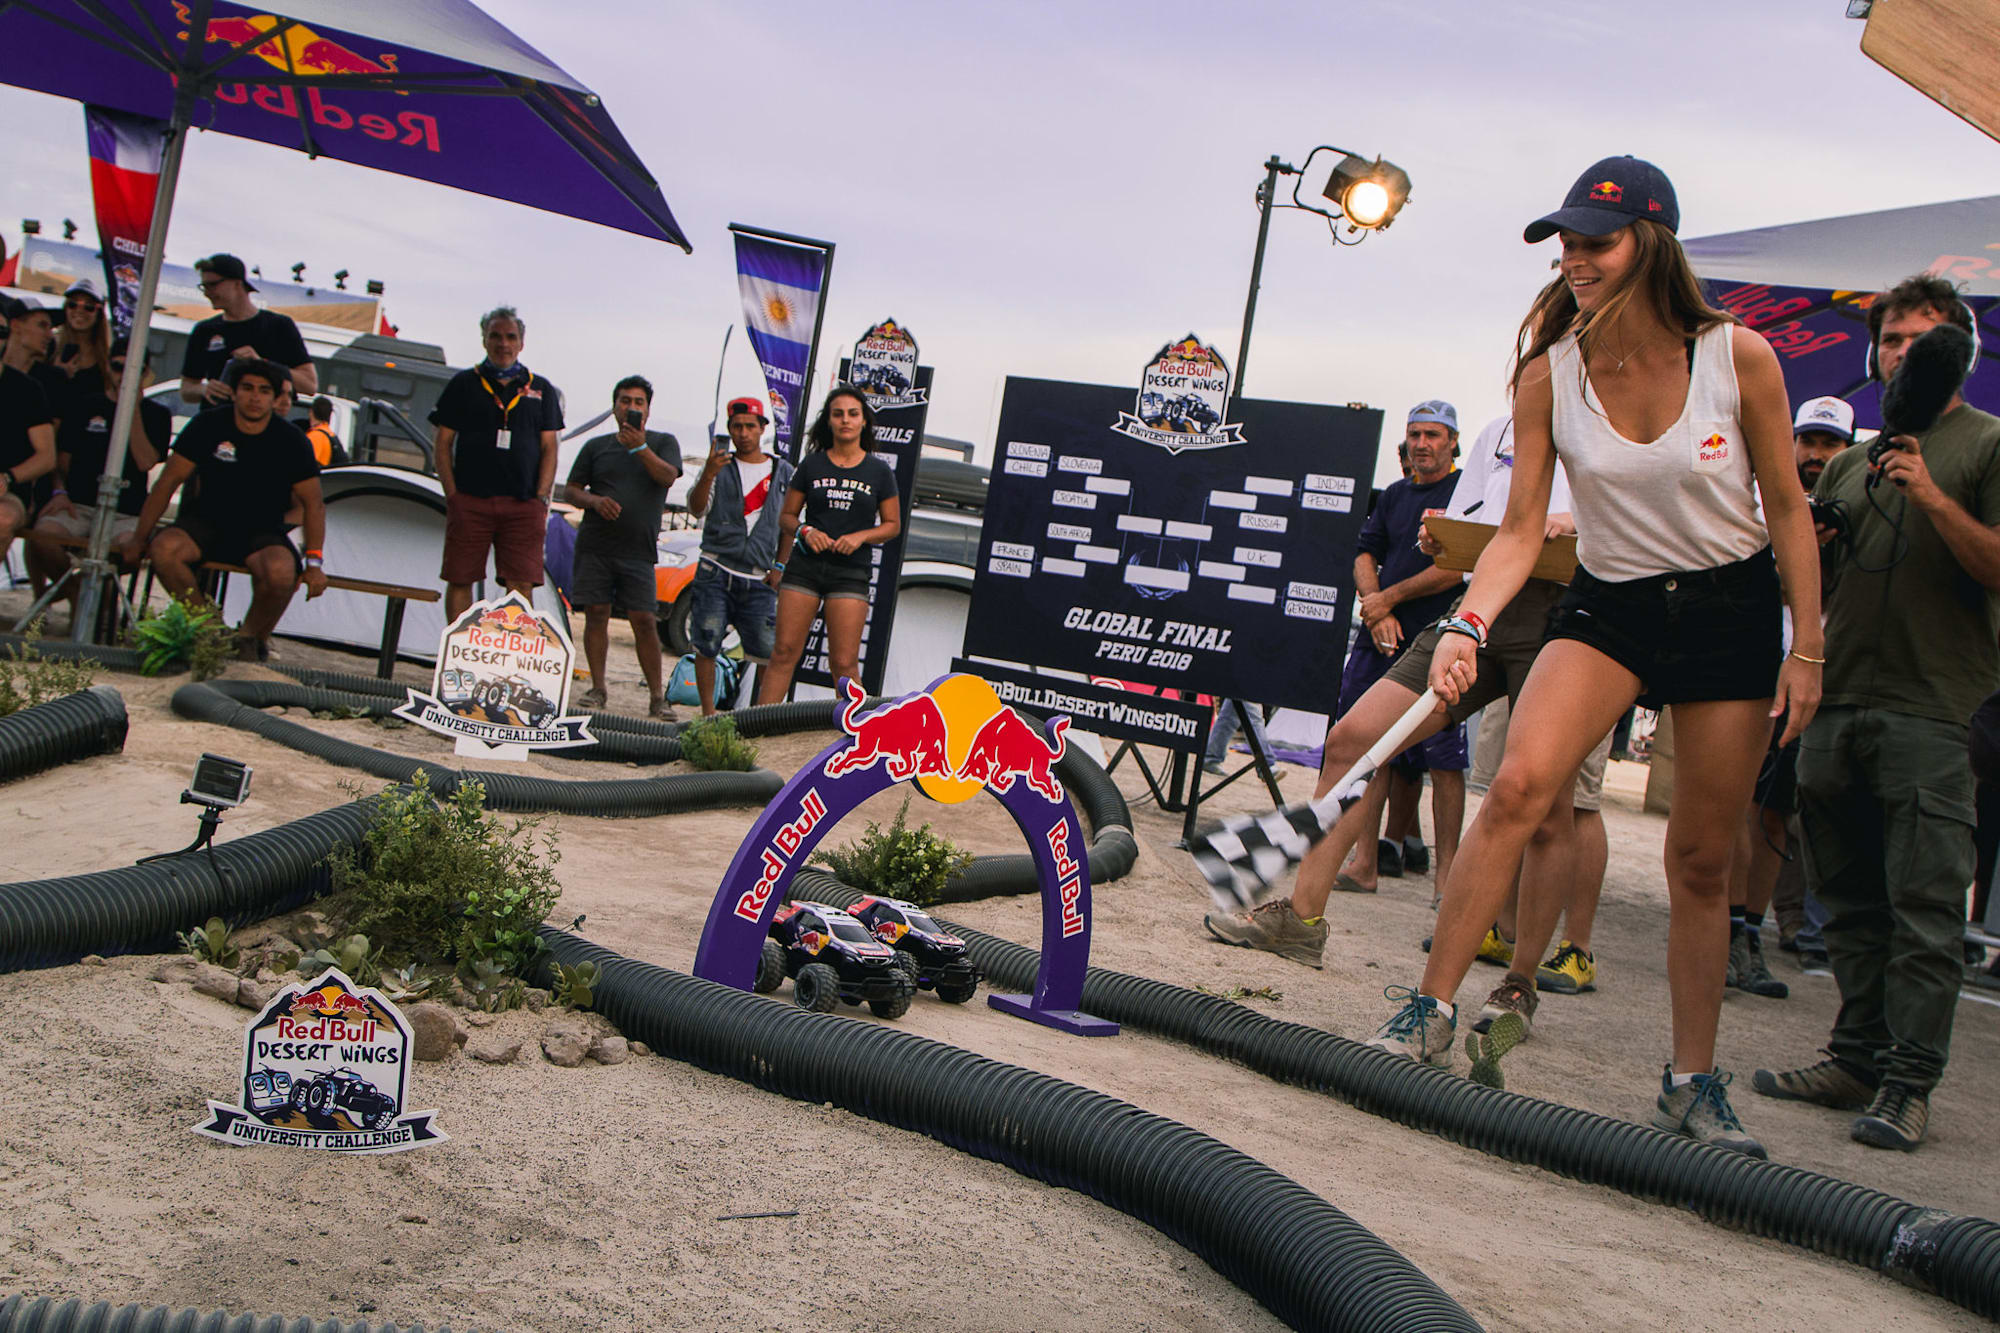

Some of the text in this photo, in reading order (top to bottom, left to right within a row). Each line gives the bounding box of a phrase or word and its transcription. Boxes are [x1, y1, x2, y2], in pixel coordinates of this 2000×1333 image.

[866, 337, 906, 353] Red Bull
[858, 349, 888, 360] DESERT
[1159, 359, 1213, 377] Red Bull
[1147, 374, 1189, 388] DESERT
[1129, 424, 1227, 445] UNIVERSITY CHALLENGE
[1010, 443, 1049, 459] SLOVENIA
[1011, 461, 1044, 475] CHILE
[1061, 458, 1100, 472] SLOVENIA
[813, 478, 872, 495] RED BULL
[1314, 476, 1349, 491] INDIA
[826, 488, 855, 500] SINCE
[1054, 492, 1089, 506] CROATIA
[1307, 494, 1339, 507] PERU
[1244, 515, 1282, 529] RUSSIA
[1049, 524, 1091, 539] SOUTH AFRICA
[996, 545, 1030, 559] FRANCE
[996, 560, 1022, 574] SPAIN
[1290, 585, 1337, 601] ARGENTINA
[1287, 602, 1330, 618] GERMANY
[1063, 606, 1233, 653] GLOBAL FINAL
[468, 627, 546, 655] Red Bull
[452, 644, 511, 667] DESERT
[801, 655, 817, 669] 12
[1095, 640, 1194, 672] PERU 2018
[425, 709, 567, 742] UNIVERSITY CHALLENGE
[736, 790, 826, 922] Red Bull
[1048, 819, 1083, 937] Red Bull
[278, 1017, 376, 1043] Red Bull
[257, 1041, 334, 1062] DESERT
[233, 1122, 411, 1149] UNIVERSITY CHALLENGE
